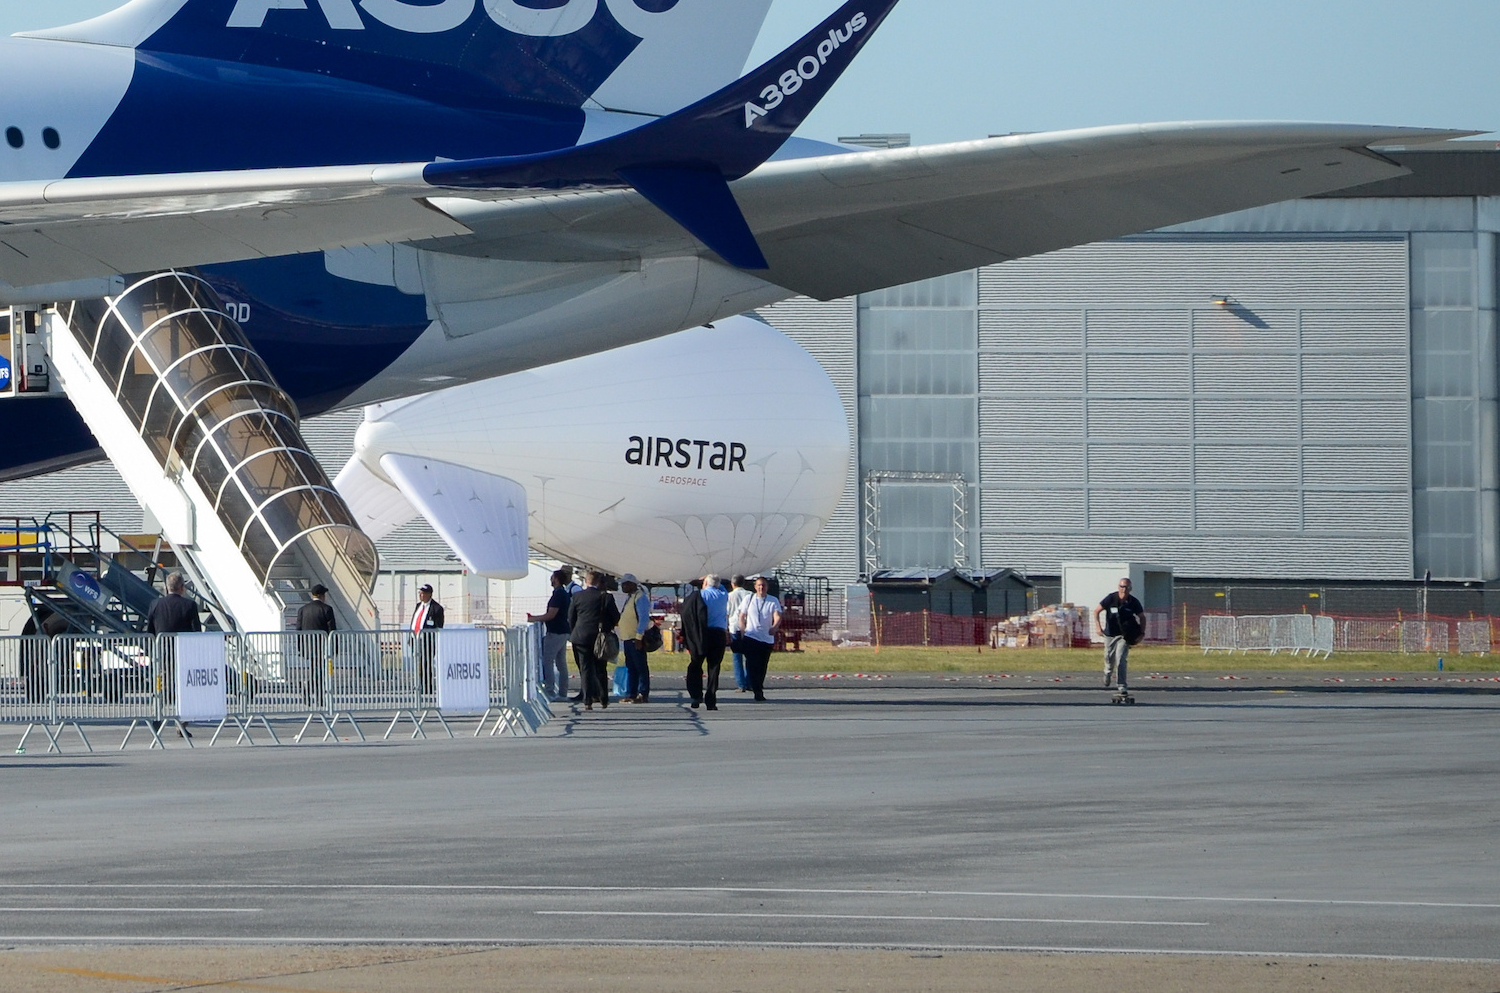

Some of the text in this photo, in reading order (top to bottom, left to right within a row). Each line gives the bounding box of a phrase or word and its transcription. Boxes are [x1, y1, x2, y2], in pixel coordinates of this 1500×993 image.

[658, 475, 708, 487] AEROSPACE
[83, 585, 99, 600] WFS
[186, 668, 218, 687] AIRBUS
[446, 662, 481, 680] AIRBUS
